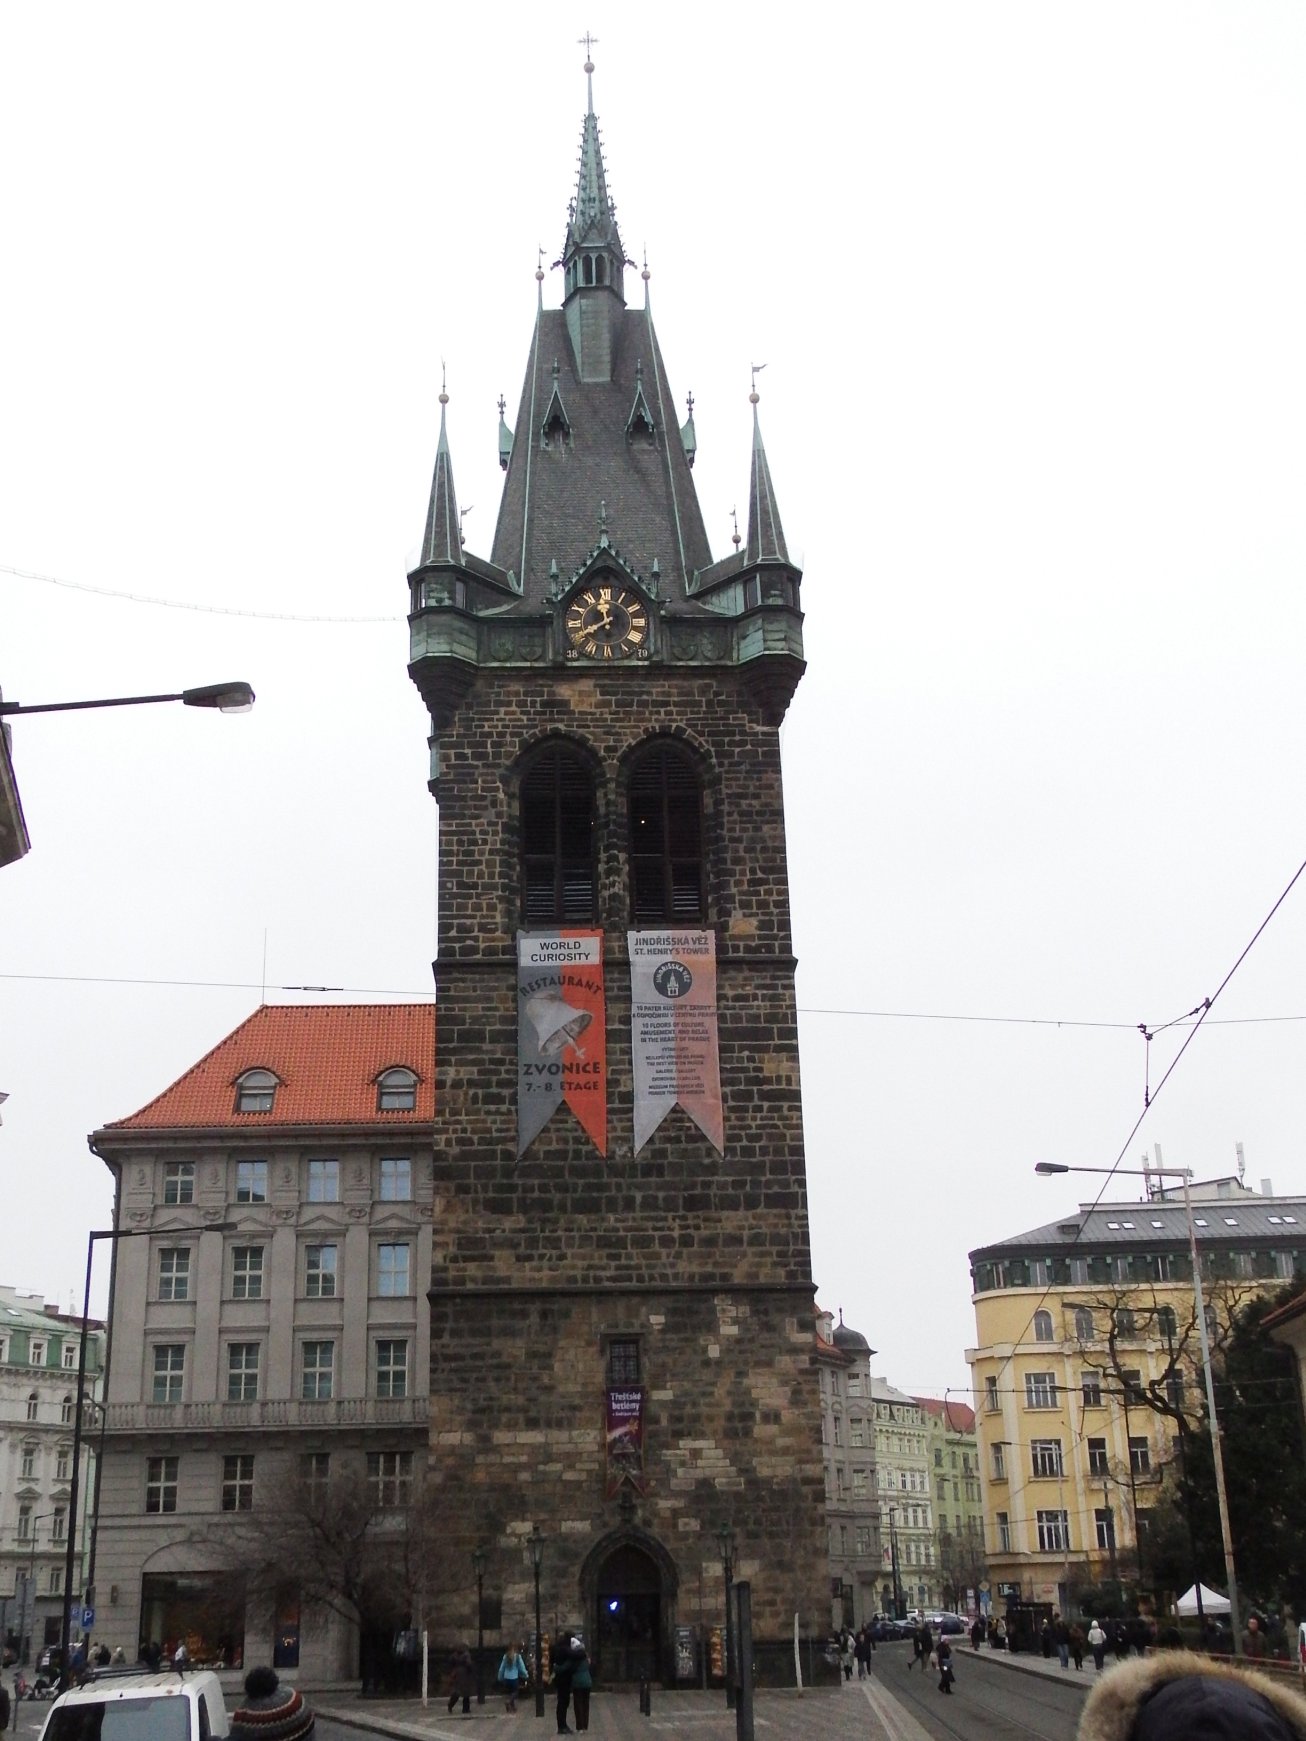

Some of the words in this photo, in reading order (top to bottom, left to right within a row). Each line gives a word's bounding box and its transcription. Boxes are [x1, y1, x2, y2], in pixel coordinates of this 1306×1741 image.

[539, 941, 581, 950] WORLD
[634, 935, 690, 946] JINDŘIŠSKÁ
[691, 934, 709, 945] VĚŽ
[530, 952, 591, 962] CURIOSITY
[634, 948, 646, 956] ST.
[647, 947, 680, 956] HENRY'S
[682, 947, 710, 955] TOWER
[519, 975, 602, 997] RESTAURANT
[523, 1062, 601, 1076] ZVONICE
[560, 1081, 599, 1091] ETAGE
[84, 1610, 93, 1622] P
